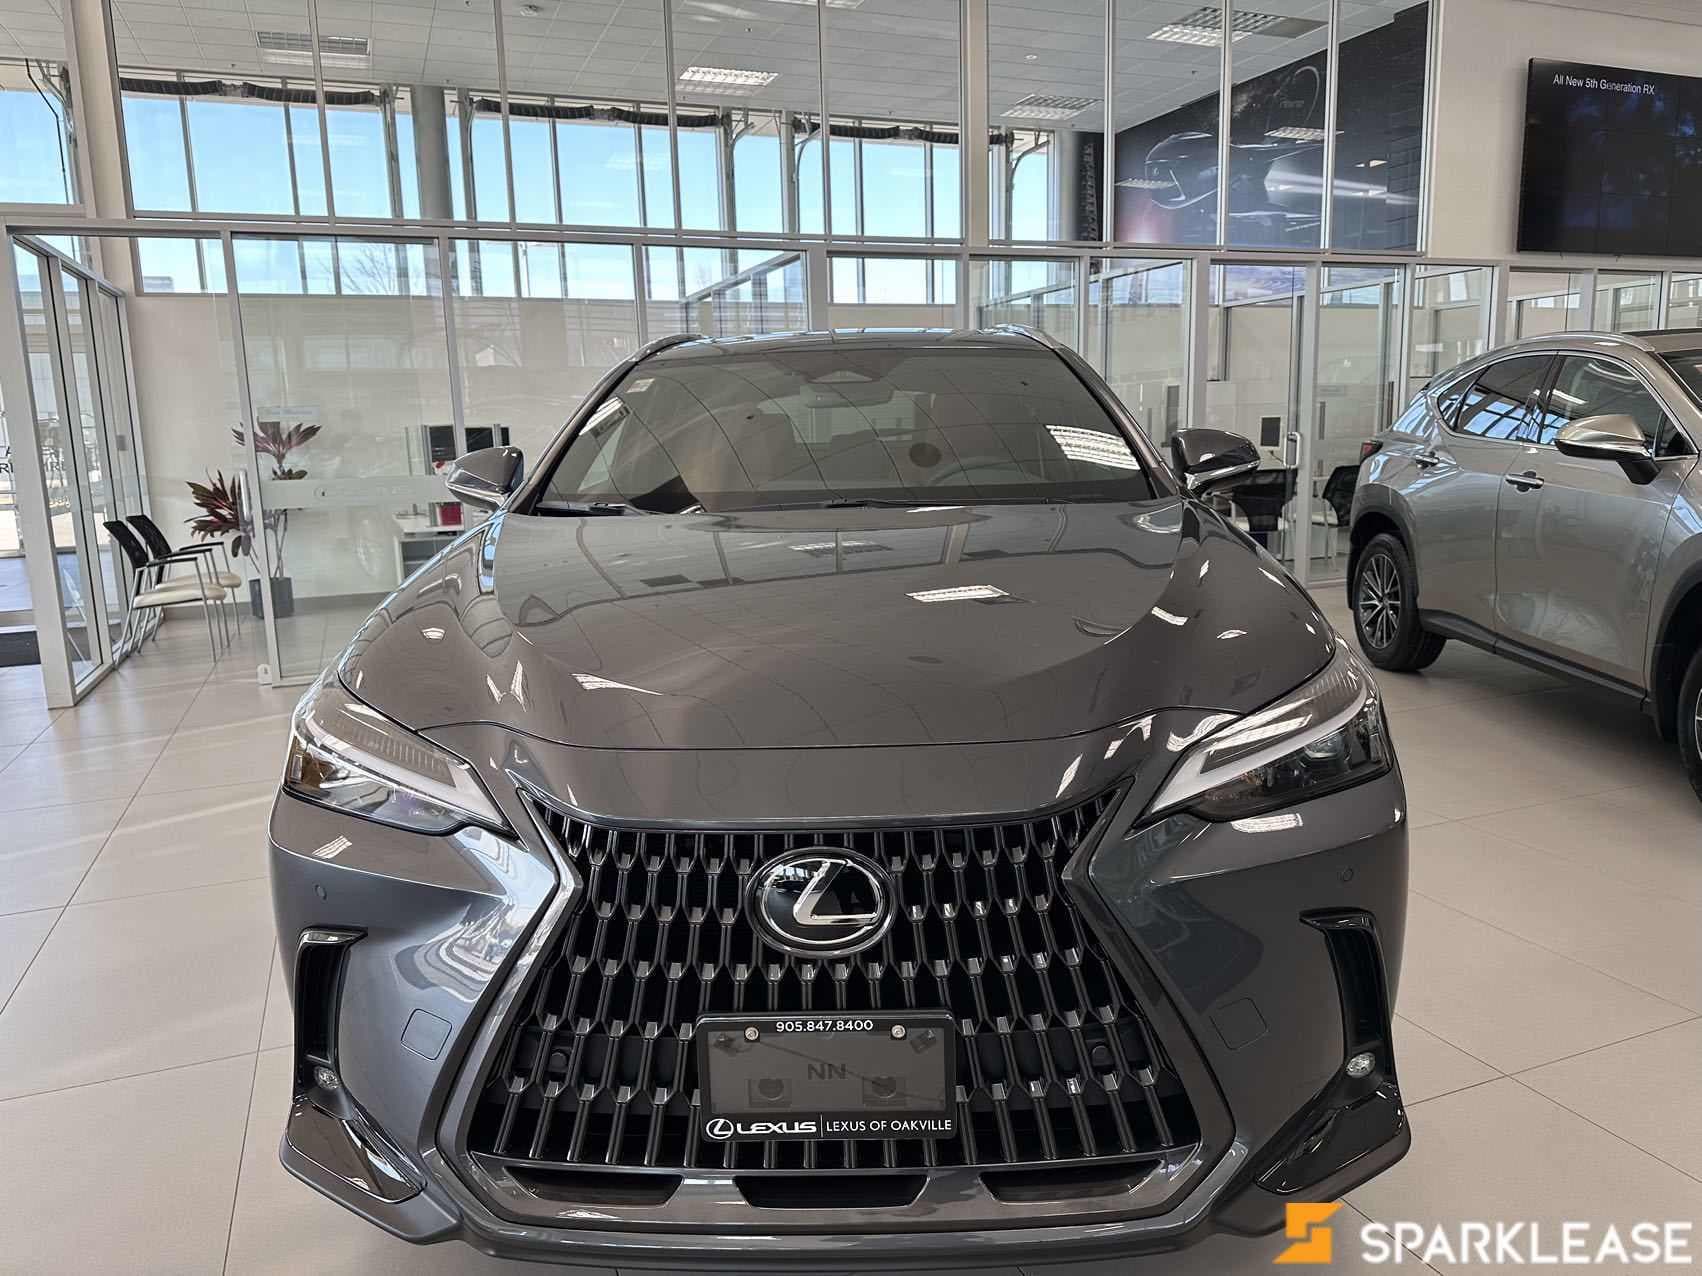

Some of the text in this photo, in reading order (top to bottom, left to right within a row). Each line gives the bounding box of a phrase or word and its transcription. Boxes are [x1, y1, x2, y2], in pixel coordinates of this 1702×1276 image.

[1553, 73, 1655, 95] All New 5th Generation RX
[776, 1020, 873, 1033] 905.847.8400
[737, 1121, 817, 1135] LEXUS
[826, 1119, 952, 1132] LEXUS OF OAKVILLE
